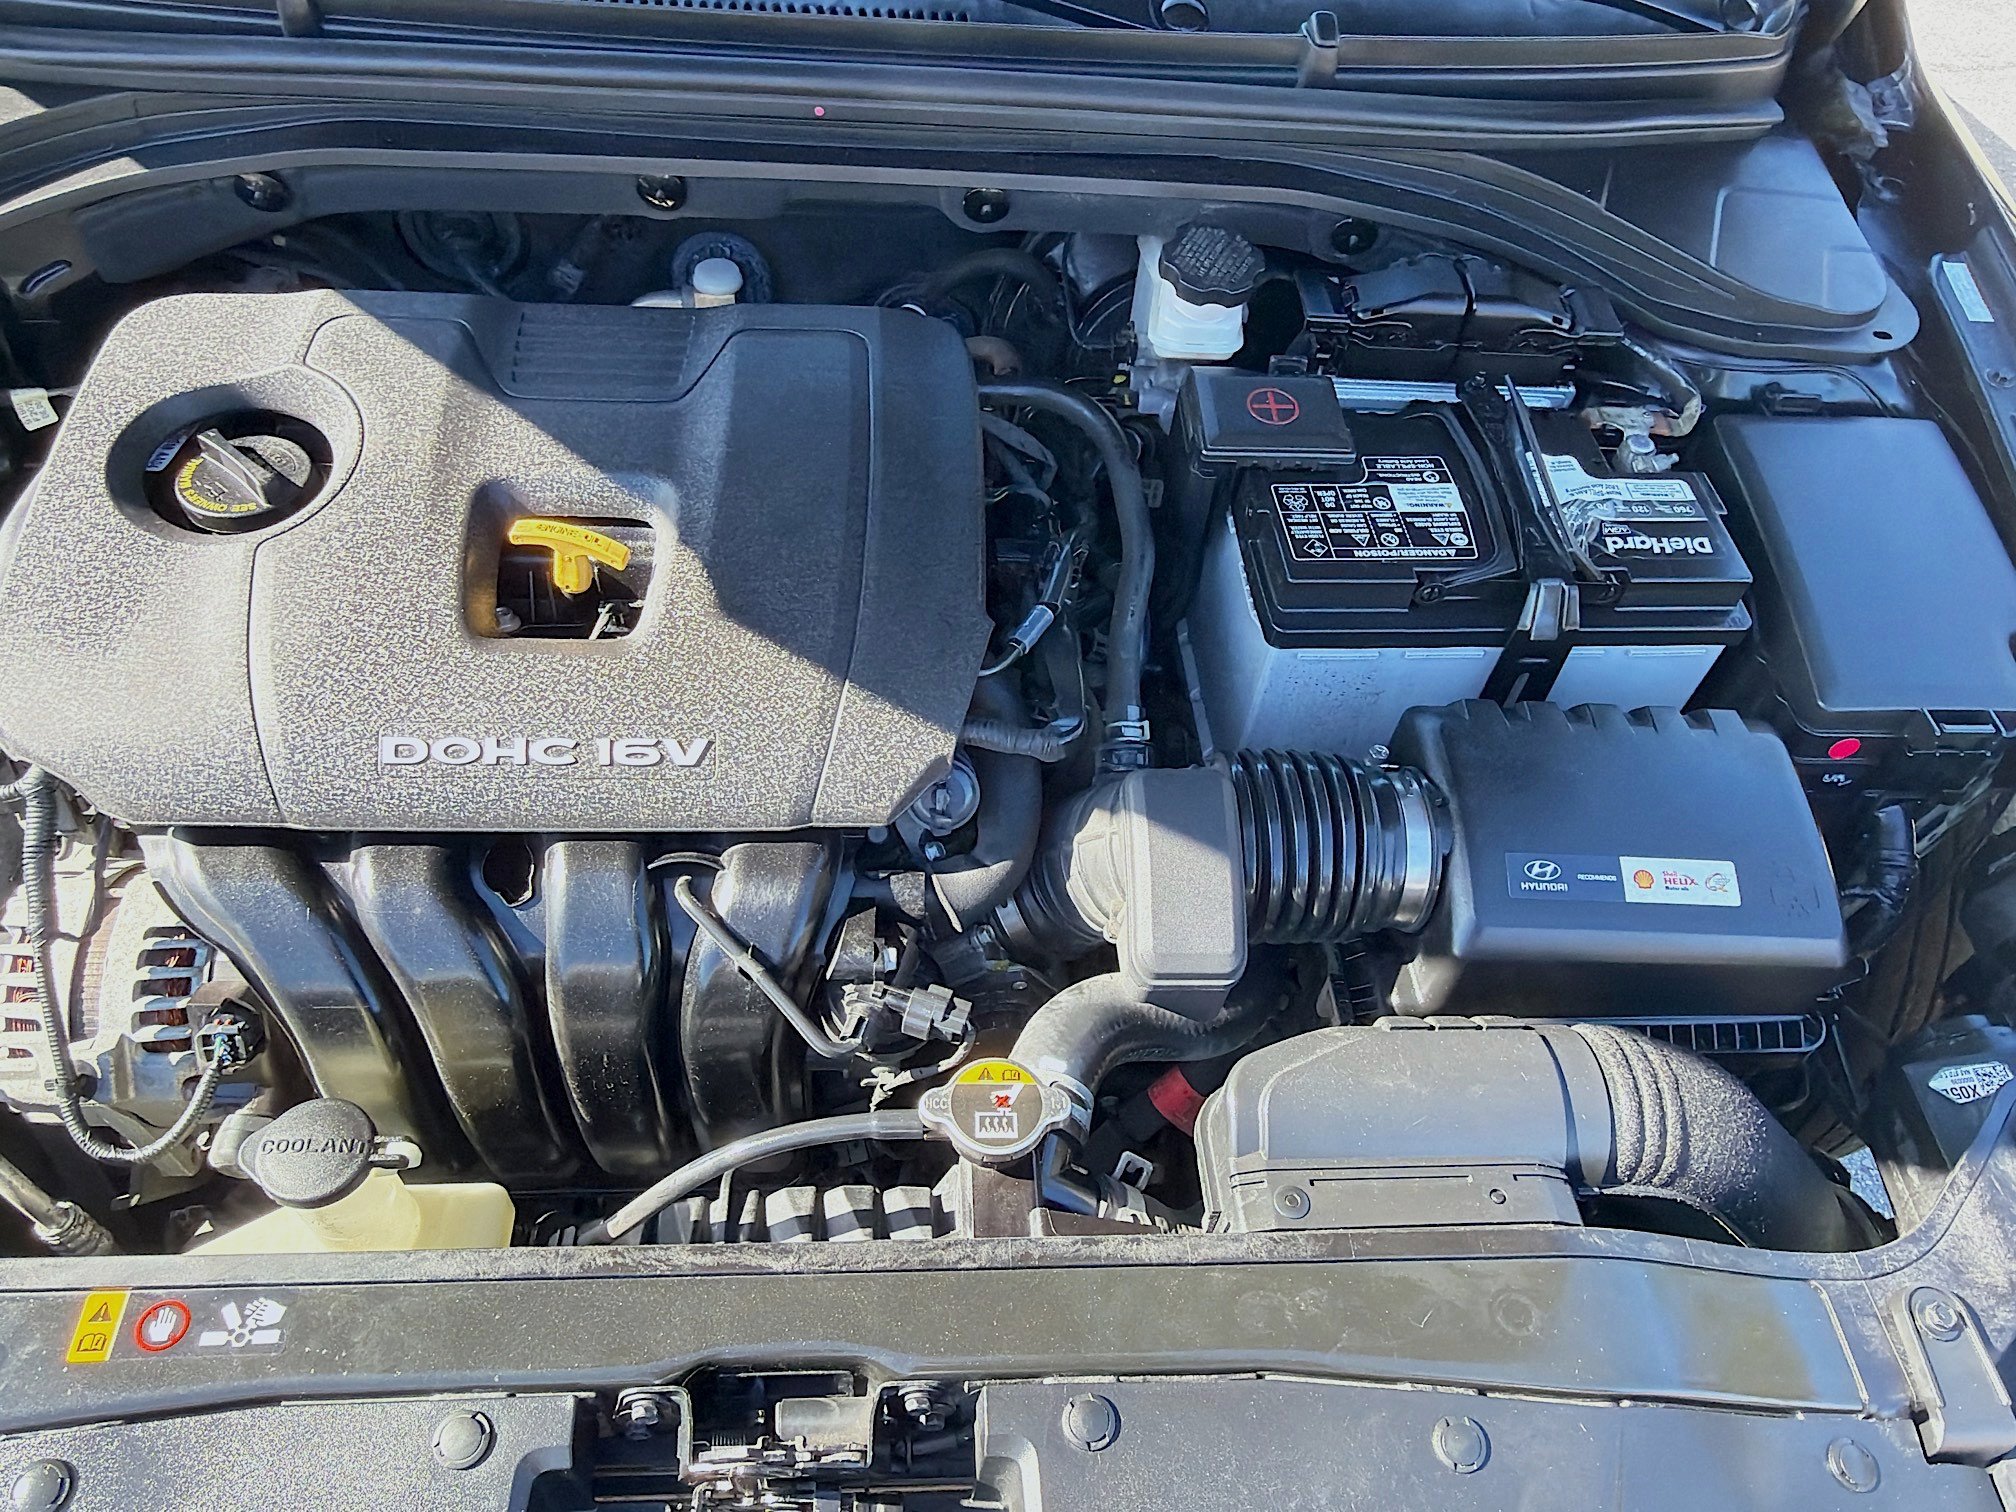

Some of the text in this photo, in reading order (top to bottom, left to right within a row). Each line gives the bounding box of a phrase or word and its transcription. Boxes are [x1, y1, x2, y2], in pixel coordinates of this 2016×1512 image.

[231, 502, 257, 512] SEE
[1631, 505, 1650, 513] 120
[1604, 526, 1628, 534] AGM
[1604, 536, 1714, 554] DieHard
[1353, 549, 1448, 557] DANGER/POISON
[381, 736, 715, 767] DOHC 16V
[1664, 877, 1698, 885] HELIX
[1520, 881, 1568, 892] HYUNDAI
[262, 1138, 368, 1155] COOLANT
